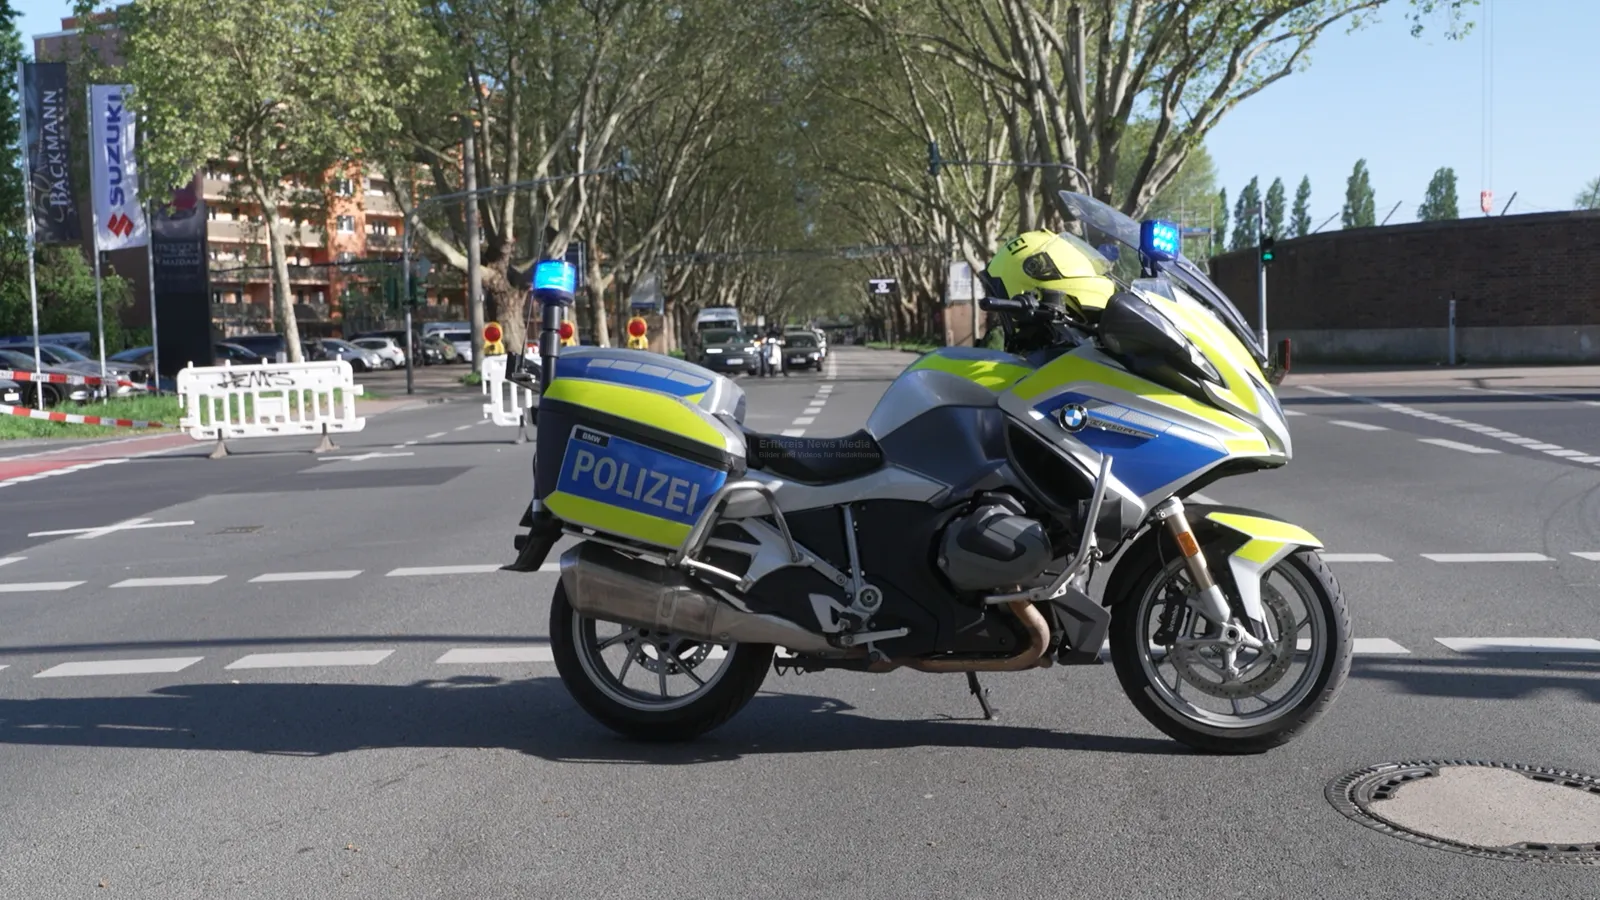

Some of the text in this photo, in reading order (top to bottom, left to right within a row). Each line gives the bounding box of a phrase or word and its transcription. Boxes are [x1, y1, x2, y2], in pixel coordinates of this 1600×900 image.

[43, 90, 68, 205] BACKMANN
[106, 94, 125, 206] SUZUKI
[582, 432, 601, 444] BMW
[571, 449, 700, 516] POLIZEI
[1167, 604, 1180, 632] brembo
